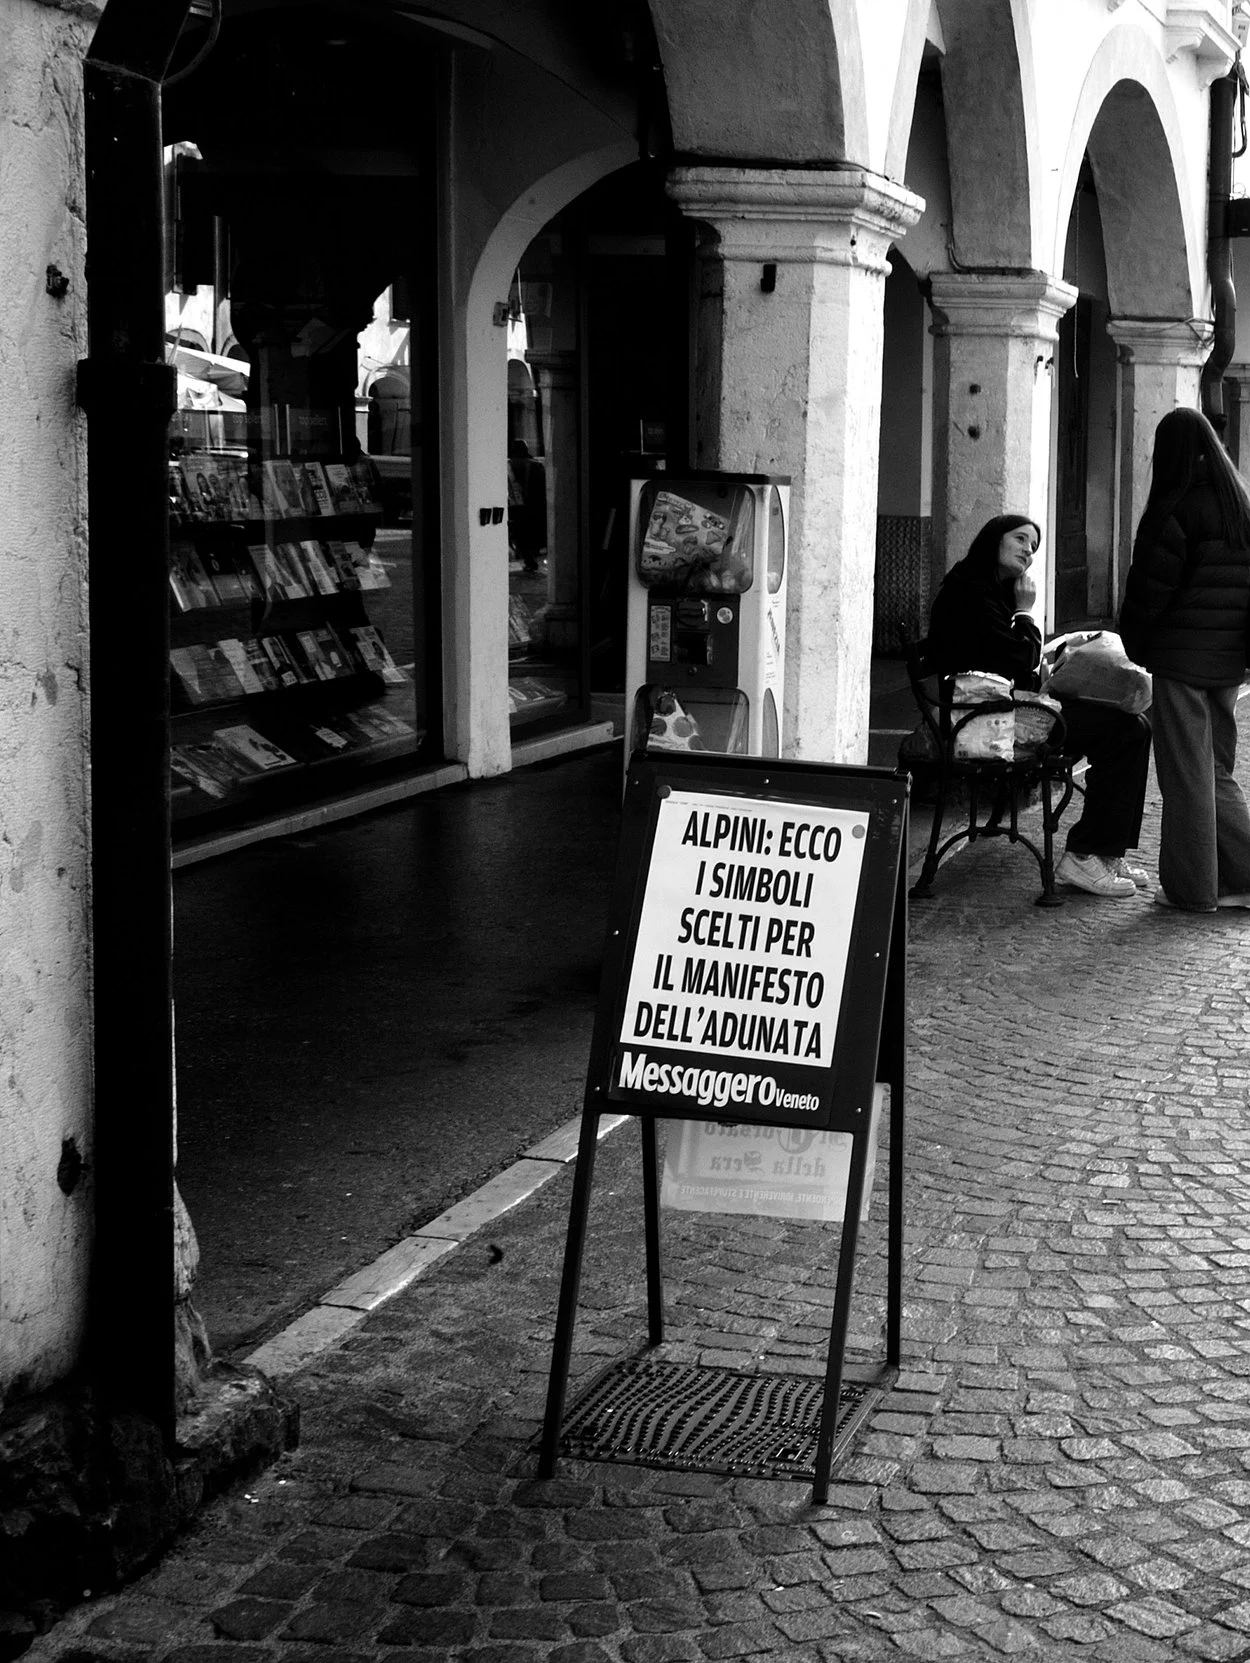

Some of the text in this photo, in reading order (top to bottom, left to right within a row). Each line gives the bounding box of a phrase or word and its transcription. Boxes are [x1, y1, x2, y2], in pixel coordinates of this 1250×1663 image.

[681, 810, 842, 862] ALPINI: ECCO
[695, 860, 814, 908] I SIMBOLI
[677, 907, 815, 958] SCELTI PER
[653, 953, 825, 1009] IL MANIFESTO
[618, 1051, 820, 1111] Messaggero Veneto
